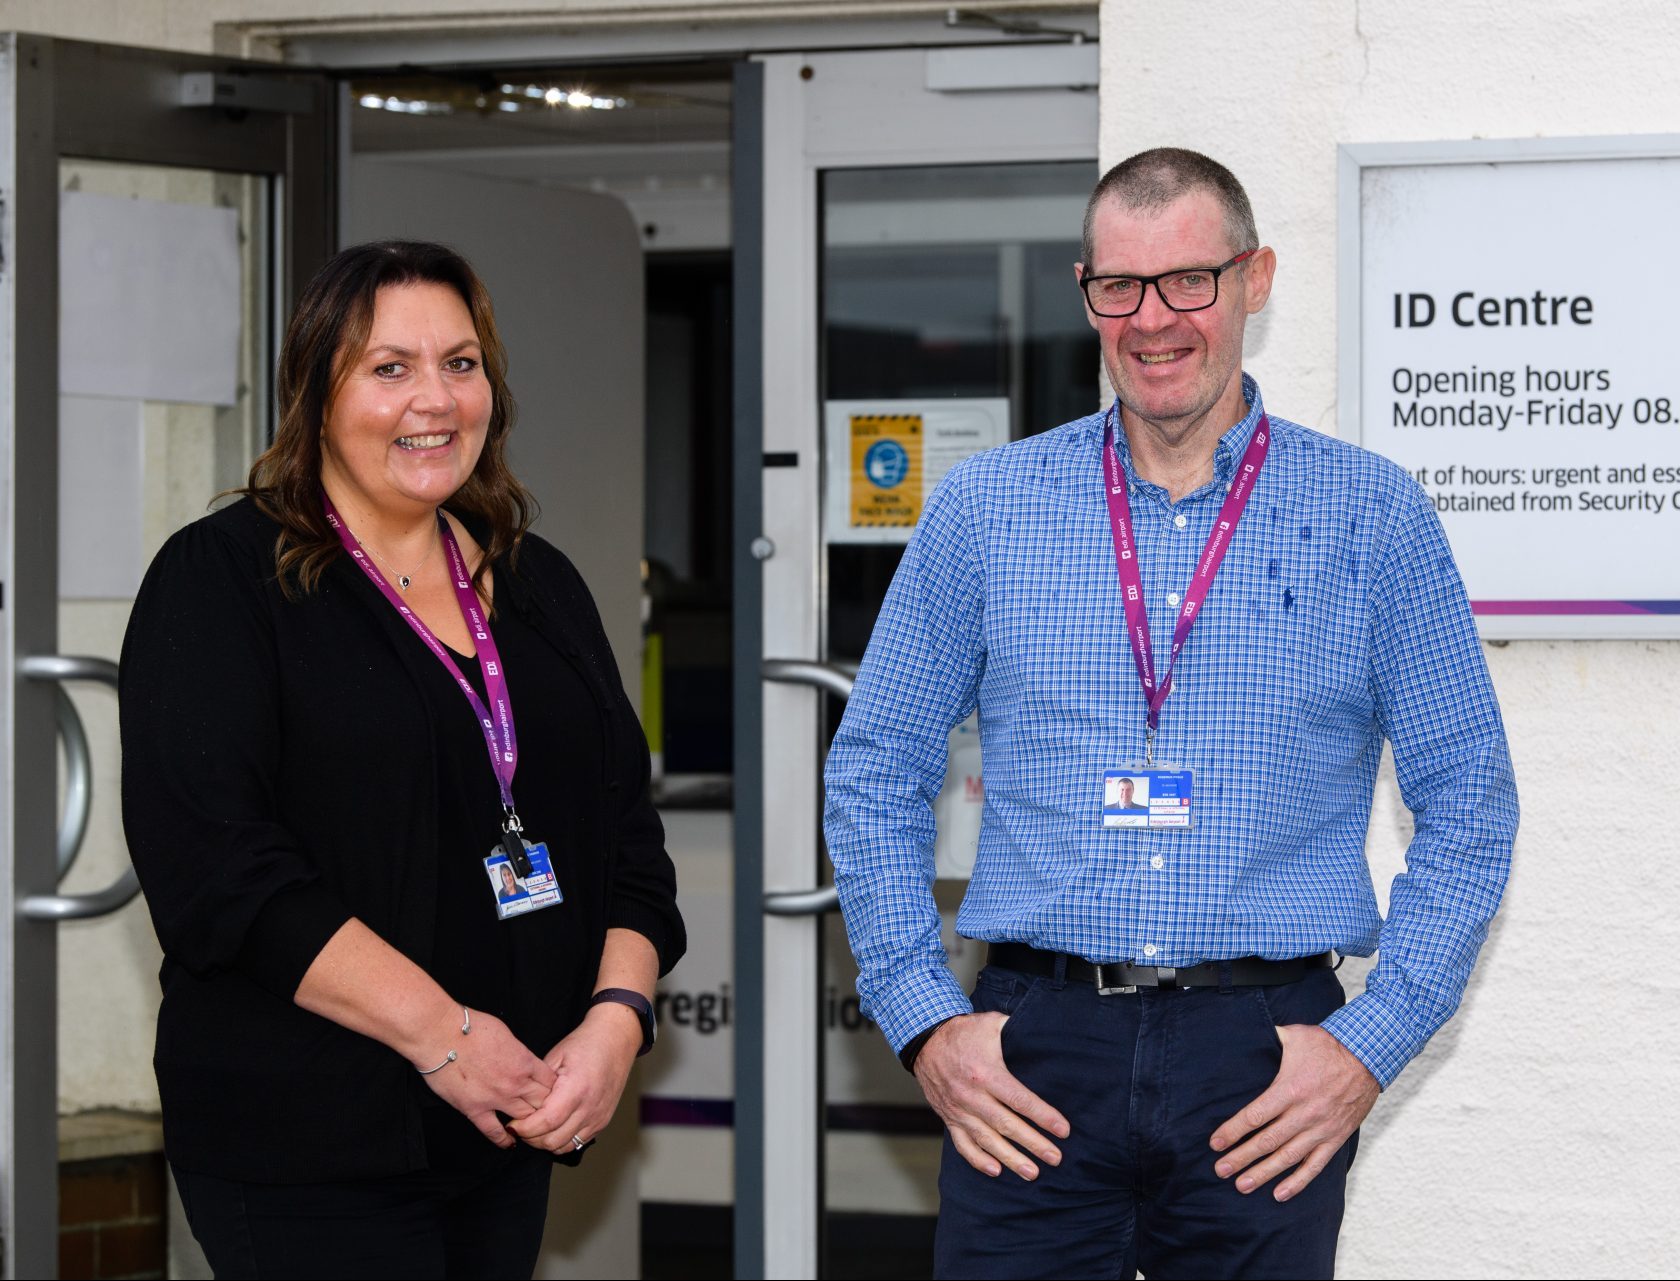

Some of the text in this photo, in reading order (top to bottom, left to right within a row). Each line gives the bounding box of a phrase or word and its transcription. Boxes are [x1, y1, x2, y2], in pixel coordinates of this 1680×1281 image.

[1394, 290, 1594, 328] ID Centre
[1393, 365, 1610, 398] Opening hours
[1393, 398, 1623, 431] Monday-Friday
[1434, 465, 1456, 485] of
[1462, 465, 1526, 485] hours:
[1532, 465, 1601, 488] urgent
[1607, 463, 1646, 484] and
[1521, 491, 1572, 511] from
[1579, 490, 1665, 514] Security
[1127, 584, 1138, 600] EDI
[1183, 601, 1195, 616] EDI
[1136, 626, 1150, 676] edinburghairport
[486, 661, 498, 676] EDI
[498, 699, 512, 750] edinburghairport
